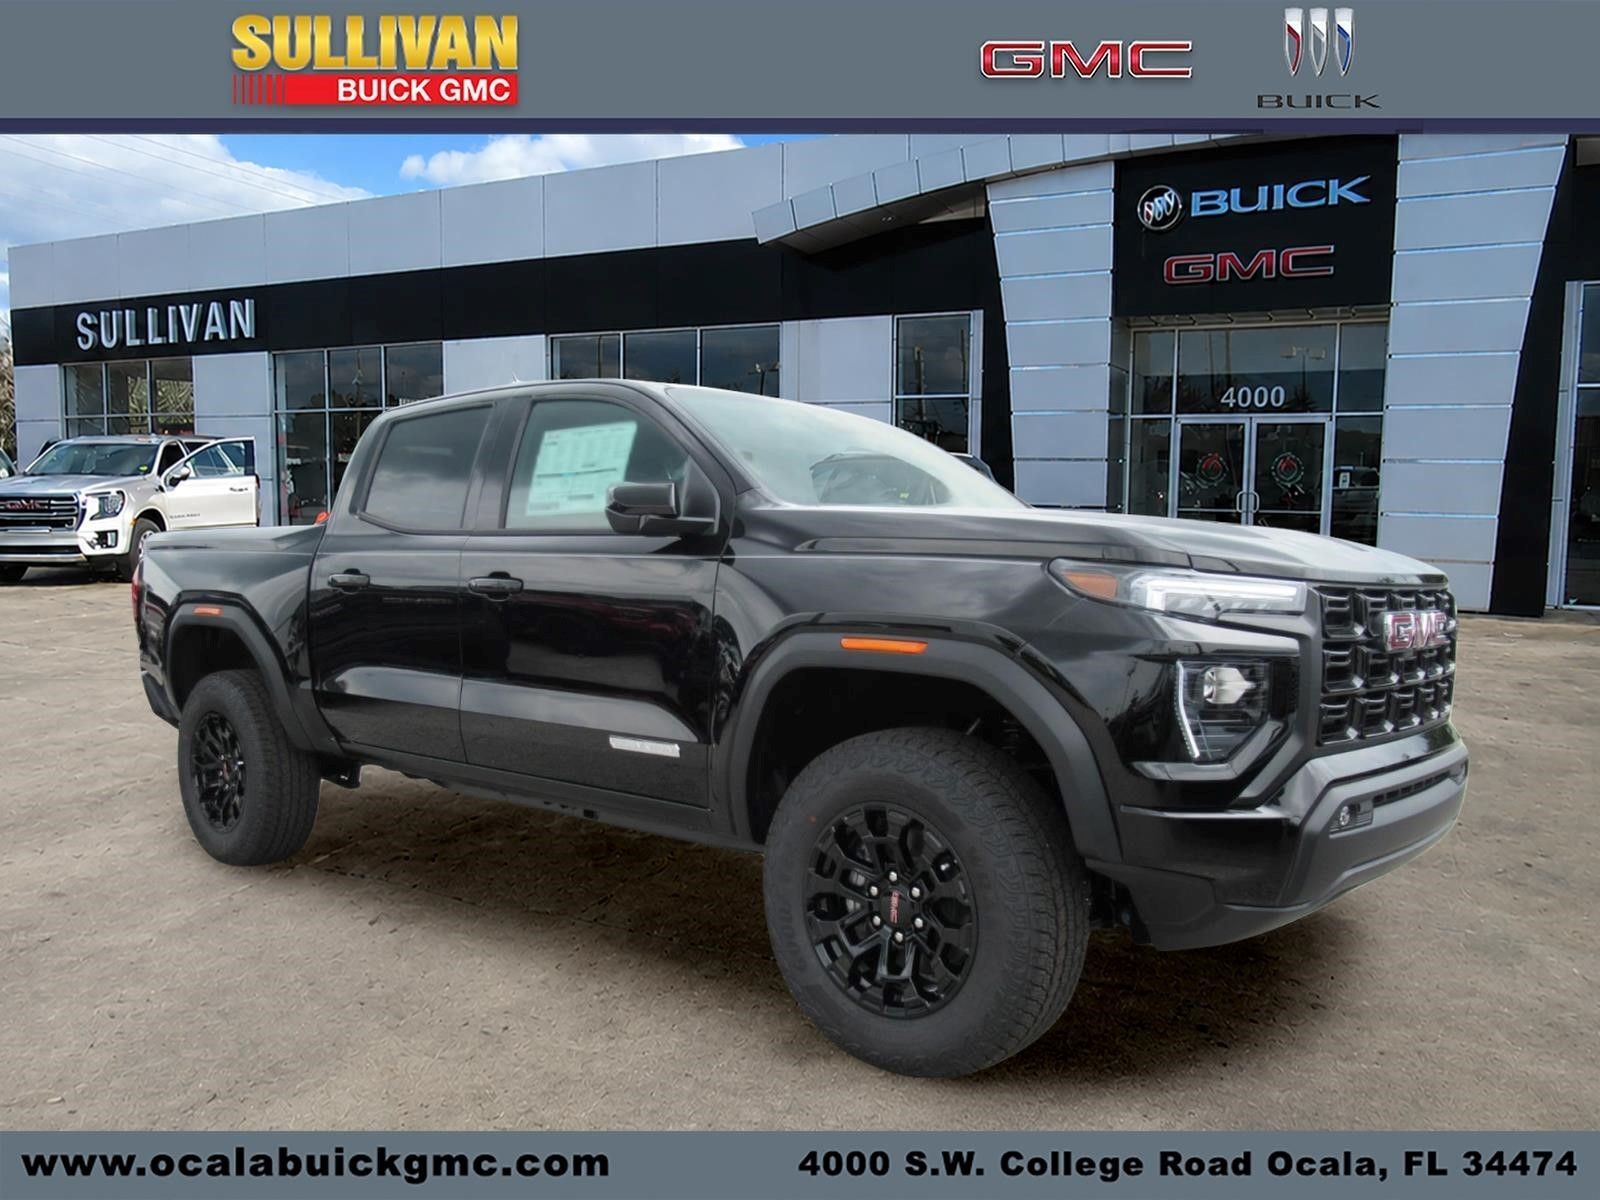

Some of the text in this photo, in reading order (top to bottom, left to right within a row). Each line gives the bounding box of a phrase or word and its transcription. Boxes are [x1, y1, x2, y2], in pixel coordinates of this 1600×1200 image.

[1191, 175, 1371, 217] BUICK
[1163, 245, 1335, 284] GMC
[76, 298, 255, 351] SULLIVAN
[1220, 386, 1286, 408] 4000
[1384, 611, 1451, 652] GMC
